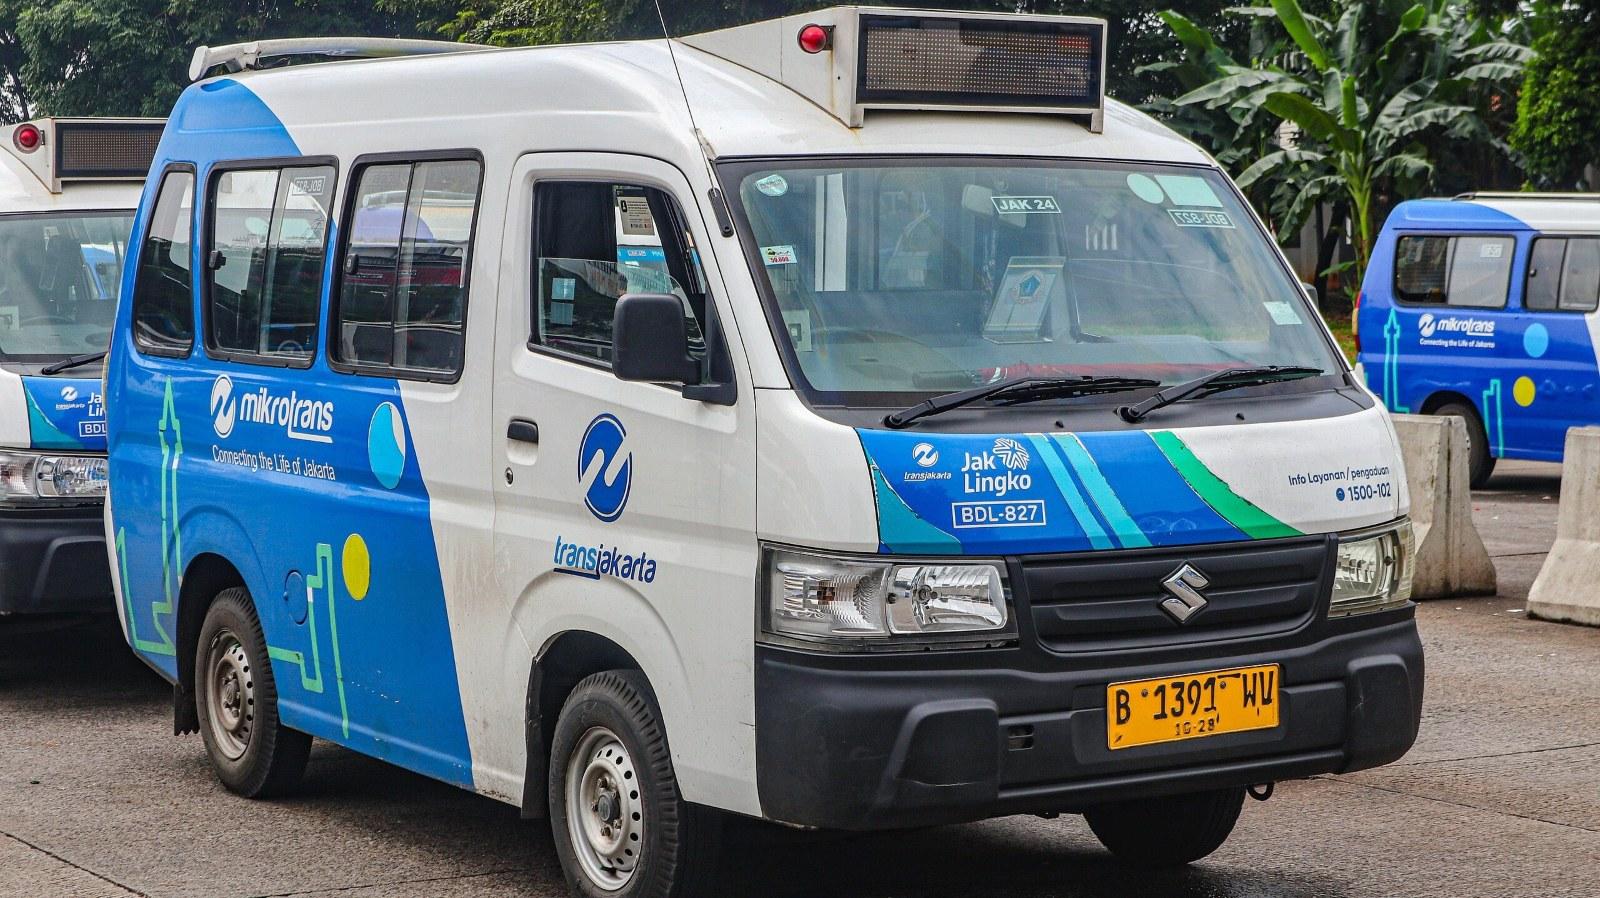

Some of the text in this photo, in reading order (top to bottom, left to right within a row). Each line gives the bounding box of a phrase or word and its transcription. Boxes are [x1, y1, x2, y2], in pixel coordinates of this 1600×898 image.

[1000, 199, 1055, 210] JAK 24
[1437, 317, 1496, 336] mikrotrans
[87, 392, 103, 404] Ja
[239, 387, 334, 443] mikrotrans
[212, 444, 336, 481] Connecting the Life of Jakarta
[961, 452, 997, 472] Jak
[903, 471, 952, 482] transjakarta
[964, 470, 1031, 497] Lingko
[1288, 473, 1306, 486] Info
[1307, 470, 1346, 485] Layanan
[1351, 465, 1390, 481] pengaduan
[1347, 482, 1392, 501] 1500-102
[961, 505, 1038, 523] BDL-827
[553, 535, 657, 584] transjakarta
[1115, 688, 1131, 725] B
[1153, 677, 1217, 720] 1391
